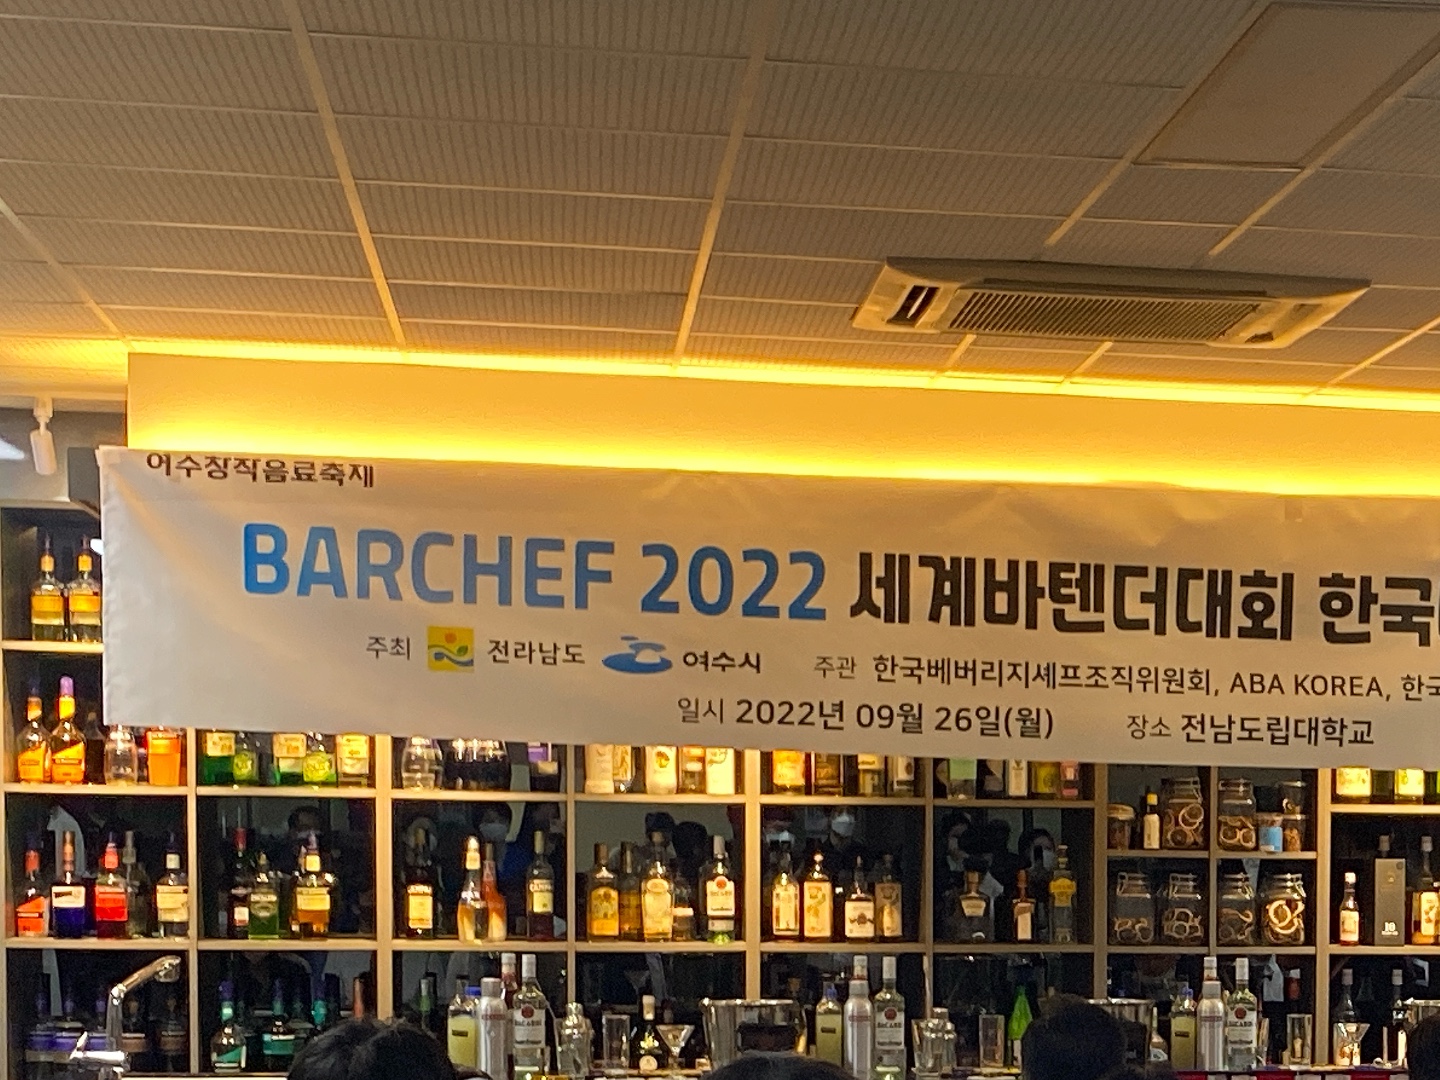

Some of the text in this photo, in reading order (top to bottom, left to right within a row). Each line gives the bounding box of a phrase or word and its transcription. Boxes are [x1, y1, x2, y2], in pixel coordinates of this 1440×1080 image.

[243, 522, 615, 610] BARCHEF
[640, 543, 827, 621] 2022
[849, 551, 1295, 642] 세계바텐더대회
[366, 636, 411, 661] 주최
[487, 638, 586, 665] 전라남도
[682, 650, 761, 674] 여수시
[813, 655, 857, 680] 주관
[1229, 672, 1286, 696] ABA
[1294, 673, 1392, 702] KOREA,
[677, 697, 1375, 748] 일시 2022년 09월 26일(월) 장소 전남도립대학교
